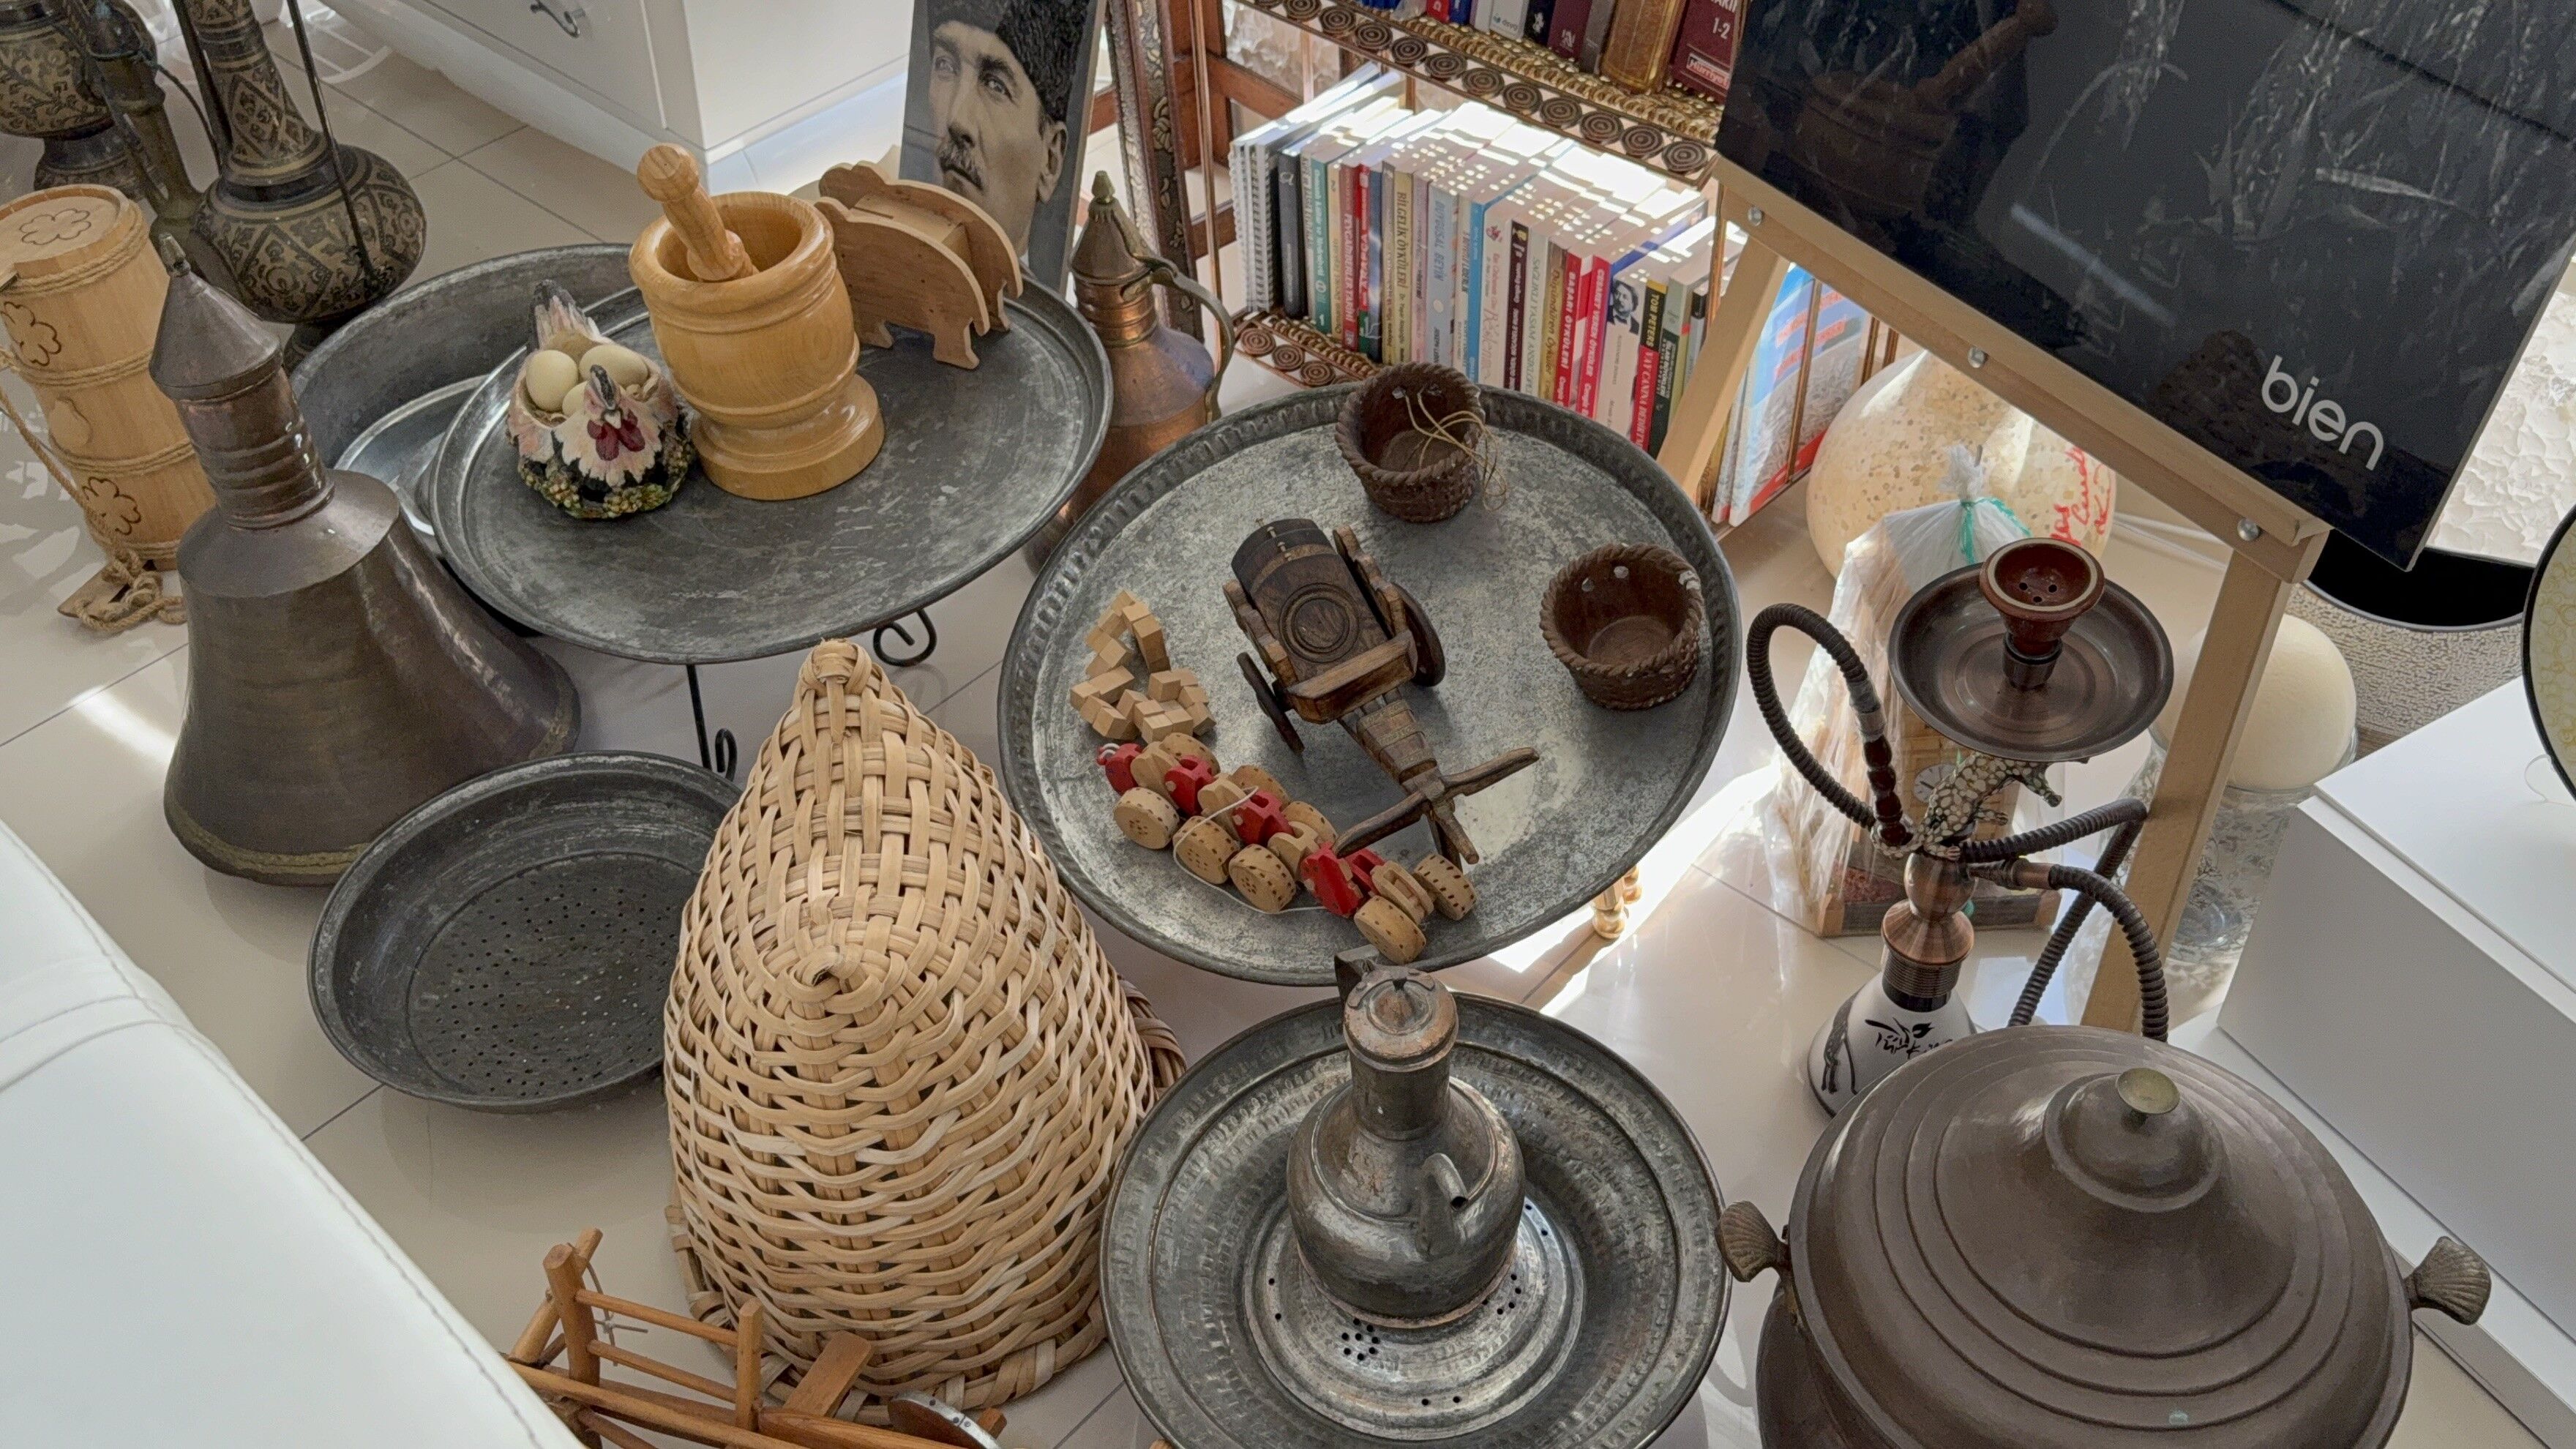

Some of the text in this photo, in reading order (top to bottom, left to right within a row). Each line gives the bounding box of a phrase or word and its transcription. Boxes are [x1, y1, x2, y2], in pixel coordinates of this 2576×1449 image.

[1712, 17, 1731, 40] 1-2
[1397, 191, 1409, 239] BİLGELİK
[1434, 200, 1445, 249] DUYGUSAL
[1344, 214, 1355, 288] PEYGAMBERLER
[1397, 240, 1409, 289] ÖYKÜLERİ
[1434, 252, 1447, 282] BEYİN
[1345, 289, 1355, 322] TARİHİ
[1548, 269, 1560, 334] Düşündüren
[1565, 271, 1576, 312] BAŞARI
[1593, 268, 1605, 309] CESARET
[1561, 314, 1573, 369] ÖYKÜLERİ
[1646, 293, 1660, 348] TOM PETERS
[1642, 351, 1655, 370] VAY
[2261, 355, 2384, 471] bien
